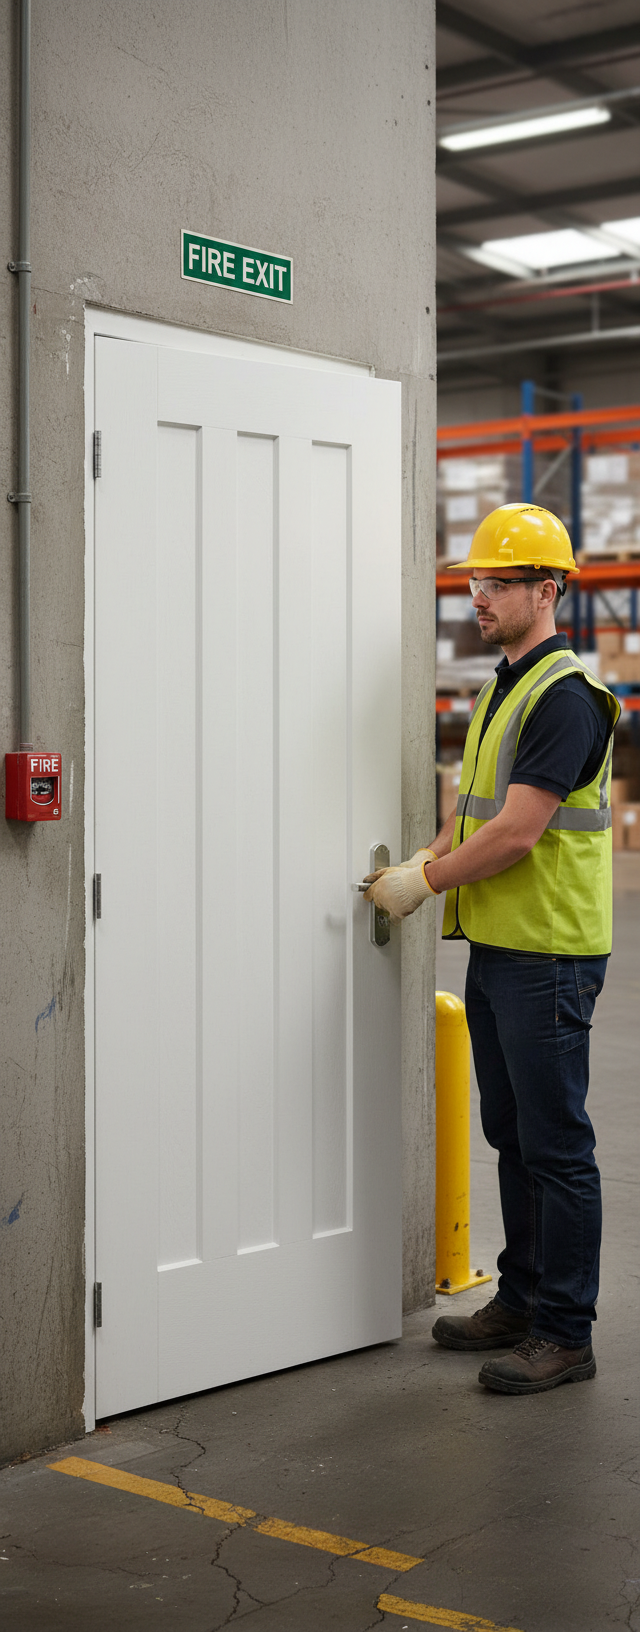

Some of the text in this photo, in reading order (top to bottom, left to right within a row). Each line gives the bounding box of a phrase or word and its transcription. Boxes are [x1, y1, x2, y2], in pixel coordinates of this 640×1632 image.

[189, 243, 287, 292] FIRE EXIT
[30, 758, 59, 772] FIRE
